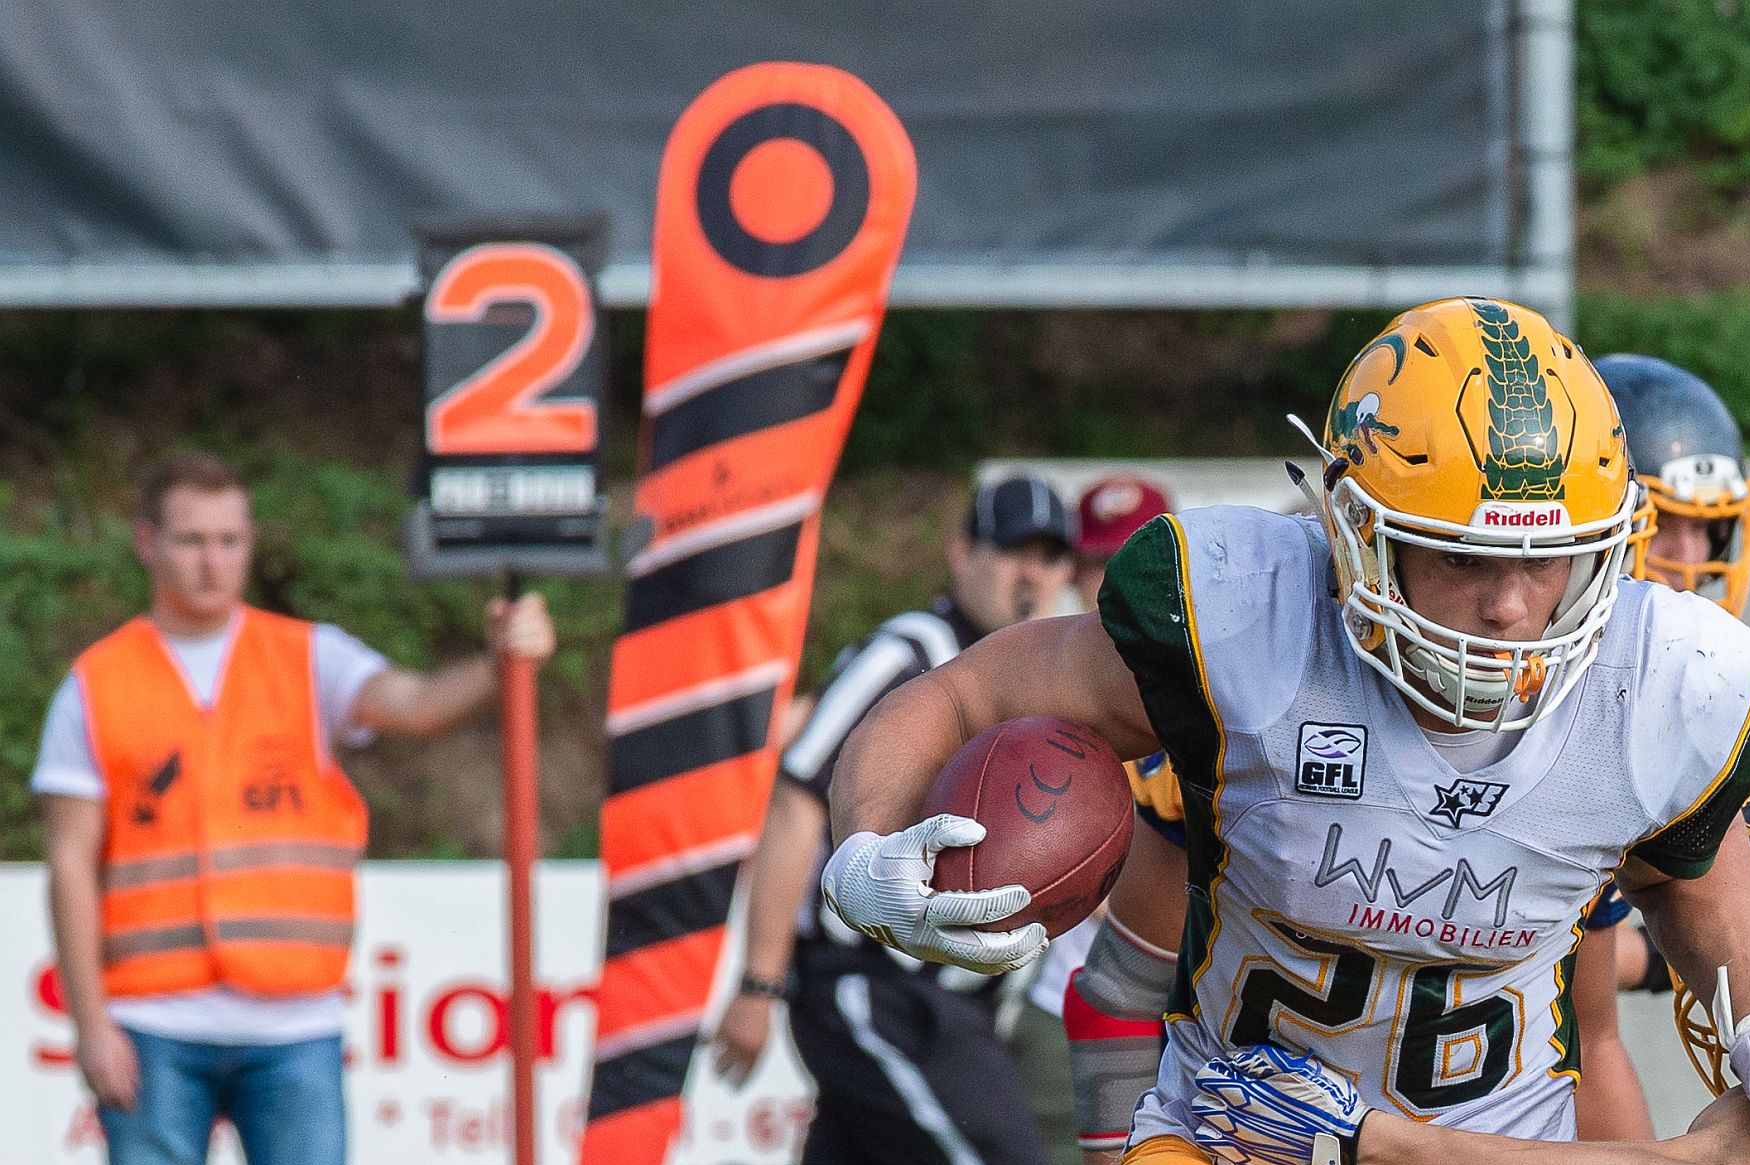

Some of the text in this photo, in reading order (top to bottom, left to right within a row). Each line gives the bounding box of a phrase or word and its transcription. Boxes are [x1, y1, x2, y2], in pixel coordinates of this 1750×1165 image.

[427, 243, 597, 456] 2
[1485, 508, 1562, 528] Riddell
[1302, 762, 1358, 788] GFL
[1348, 903, 1536, 949] IMMOBILIEN
[1221, 908, 1526, 1121] 26
